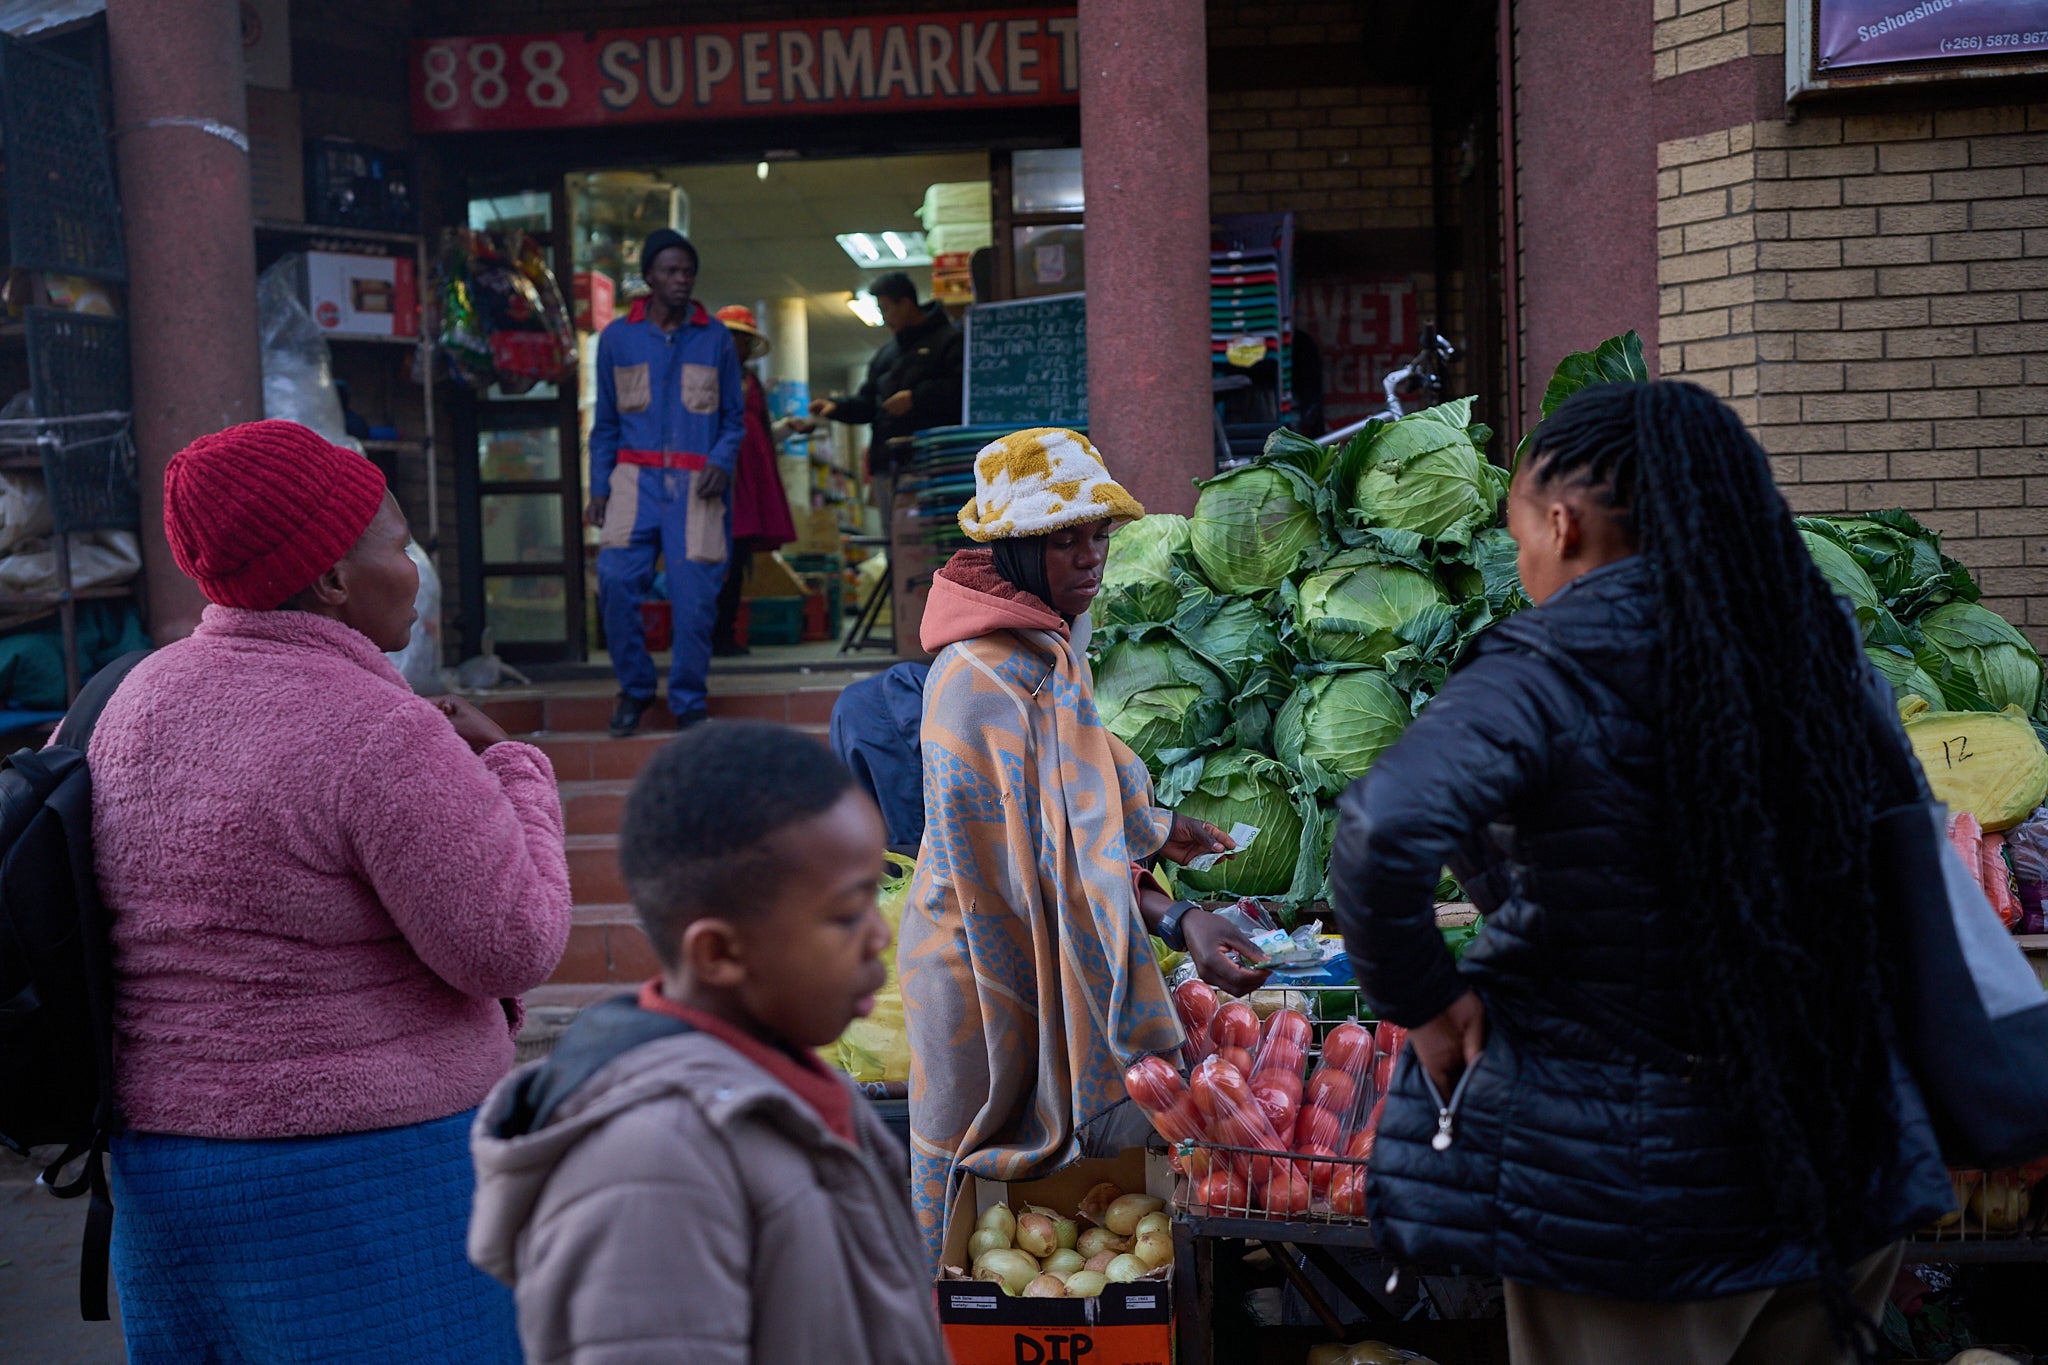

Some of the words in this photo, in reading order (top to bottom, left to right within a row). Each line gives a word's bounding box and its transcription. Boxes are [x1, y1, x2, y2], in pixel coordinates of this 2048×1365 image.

[1857, 0, 1951, 42] Seshoeshoe
[1940, 35, 1983, 53] (+266)
[1986, 34, 2020, 48] 5878
[602, 17, 1080, 111] SUPERMARKET
[1943, 735, 1974, 769] 12
